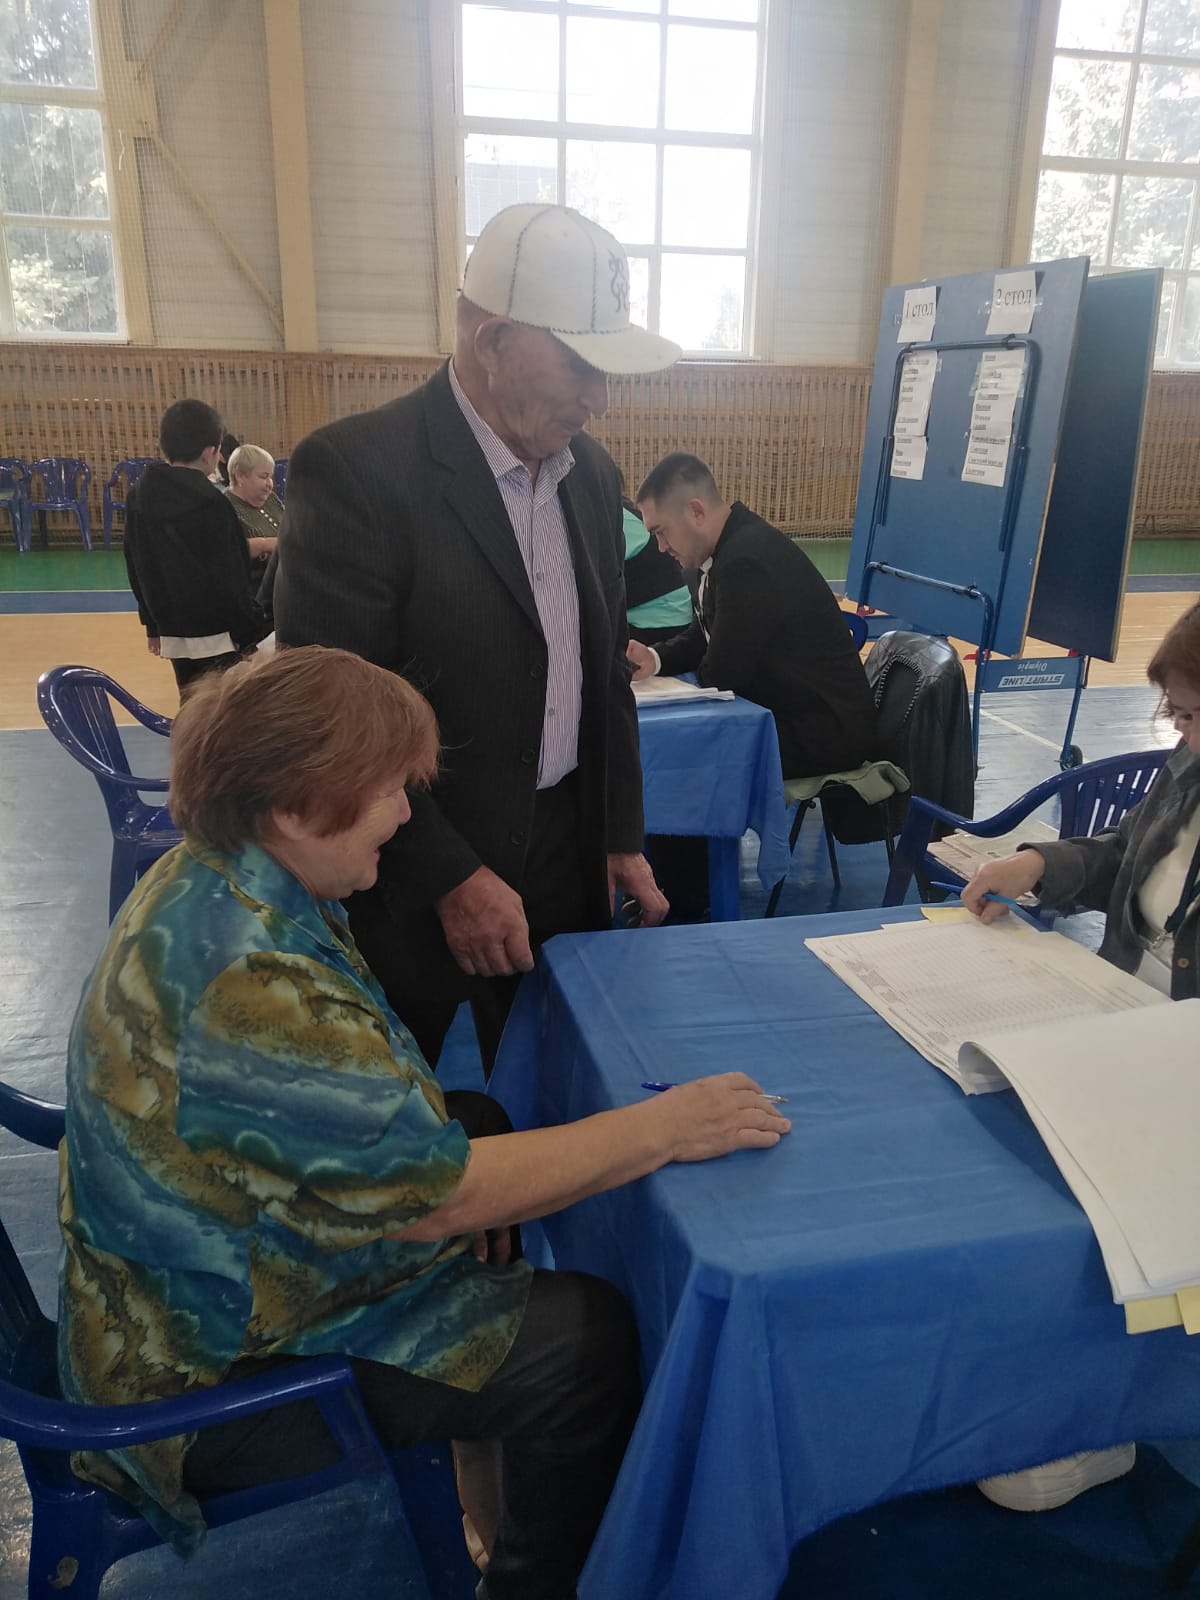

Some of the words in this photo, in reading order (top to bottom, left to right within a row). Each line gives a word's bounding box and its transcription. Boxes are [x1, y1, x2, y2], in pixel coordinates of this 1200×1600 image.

[1004, 288, 1033, 306] стол
[912, 302, 935, 318] стол
[1017, 661, 1048, 671] Olympic
[1001, 677, 1025, 687] LINE
[1025, 675, 1063, 685] START
